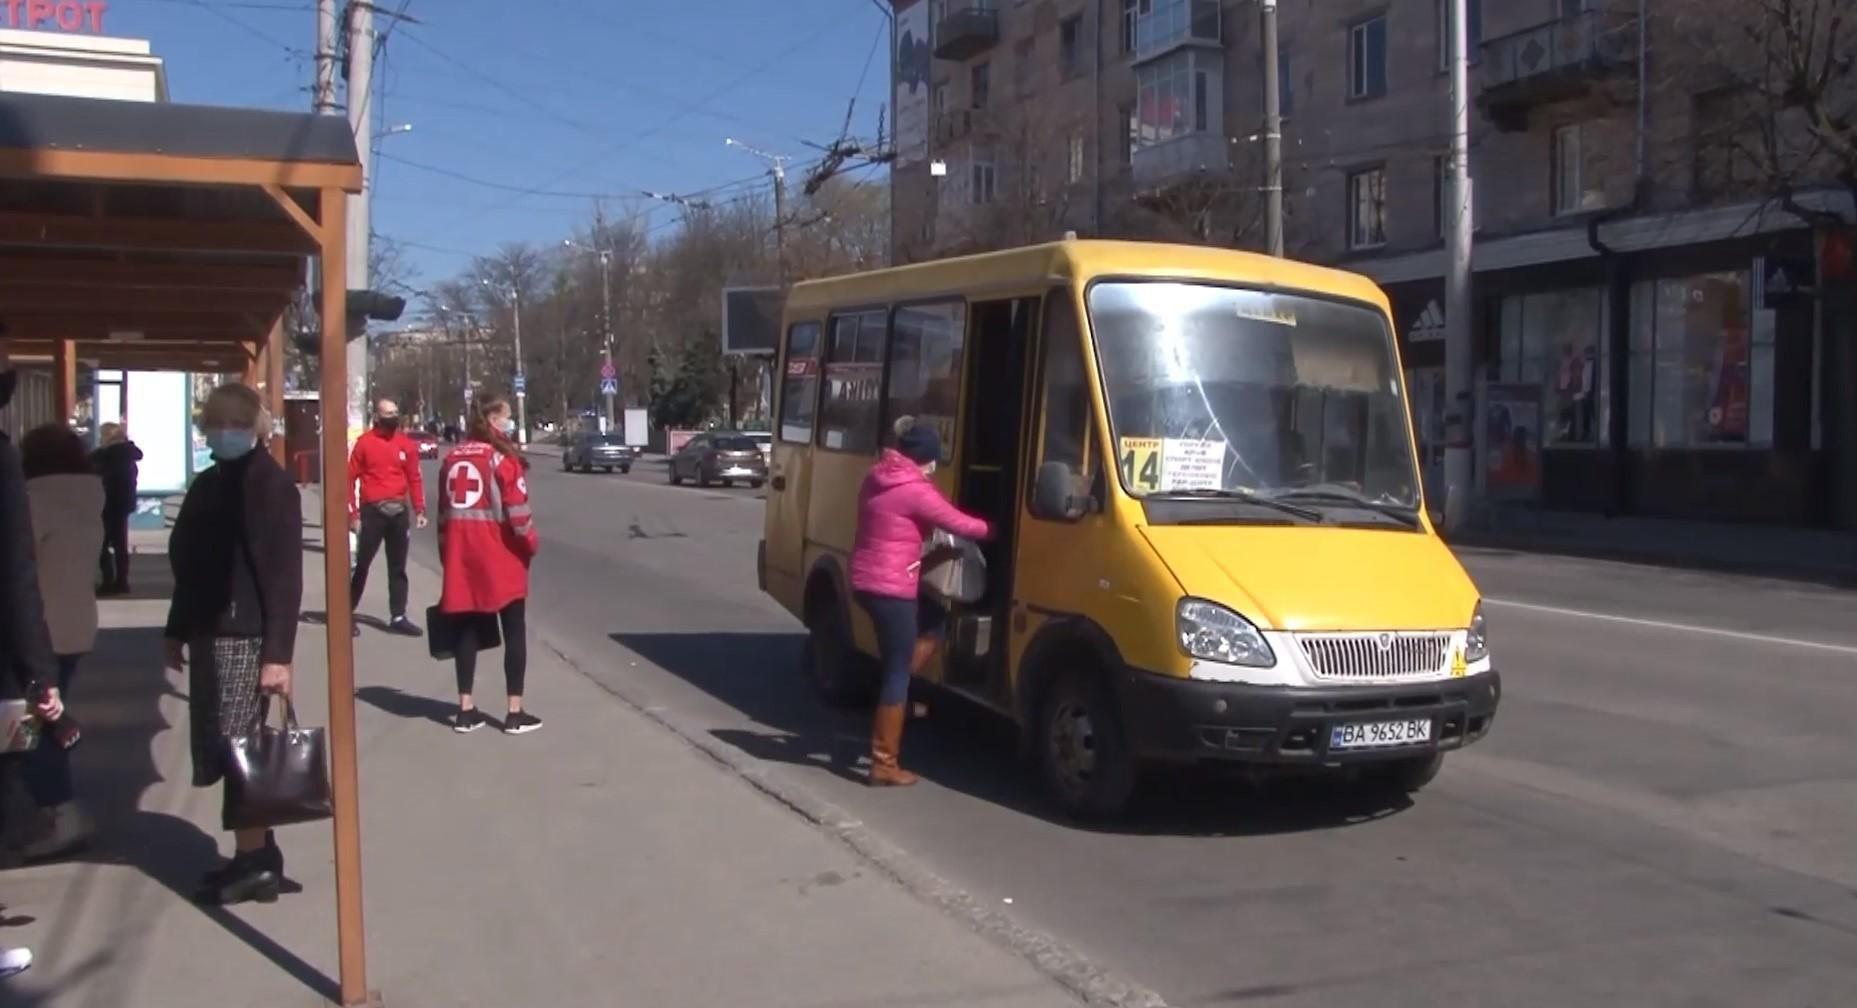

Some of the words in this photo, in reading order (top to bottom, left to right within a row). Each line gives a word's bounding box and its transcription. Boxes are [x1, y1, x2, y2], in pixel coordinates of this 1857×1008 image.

[0, 0, 105, 33] ТРОТ
[1124, 440, 1159, 449] ЦЕНТР
[1121, 449, 1159, 490] 14
[1343, 724, 1365, 742] BA
[1371, 721, 1404, 741] 9652
[1407, 720, 1427, 738] BK
